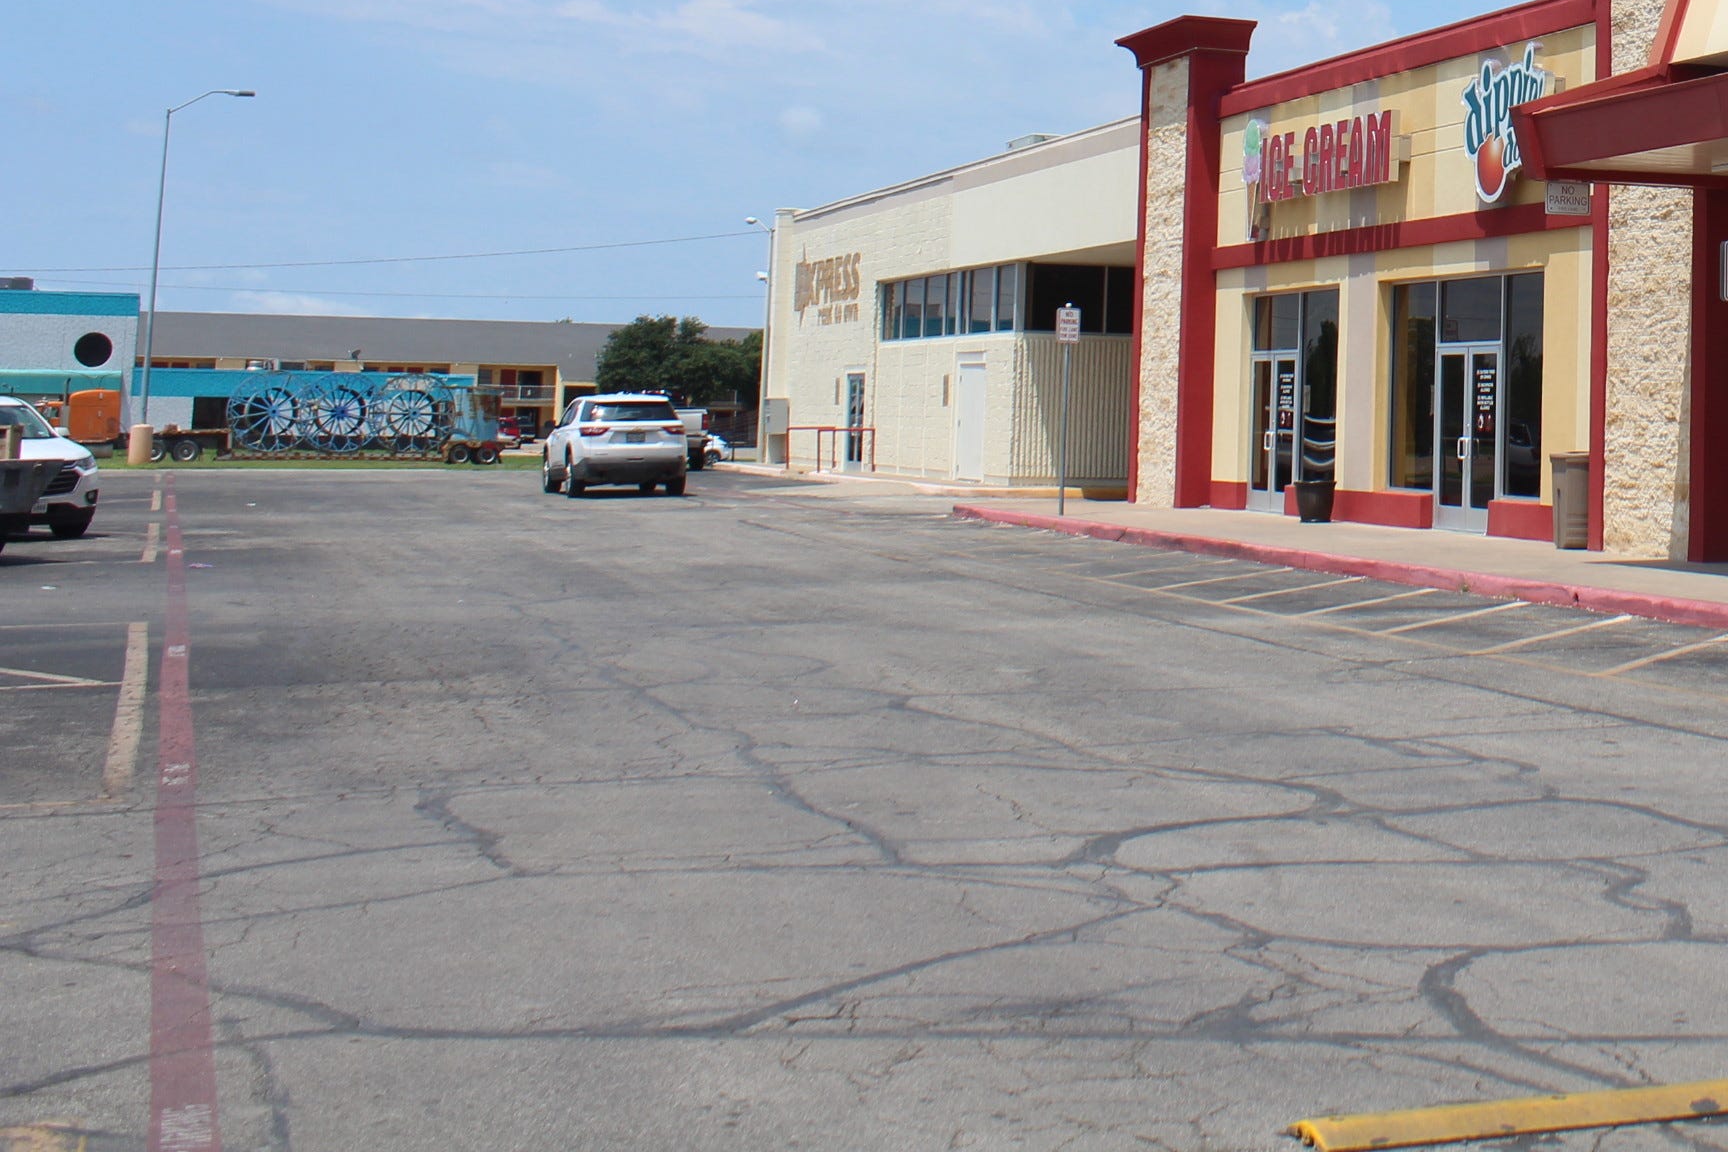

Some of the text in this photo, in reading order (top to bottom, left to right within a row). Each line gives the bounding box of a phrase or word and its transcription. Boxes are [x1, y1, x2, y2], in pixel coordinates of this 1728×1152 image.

[1259, 110, 1392, 203] ICE CREAM
[1561, 185, 1576, 195] NO
[1549, 195, 1588, 206] PARKING
